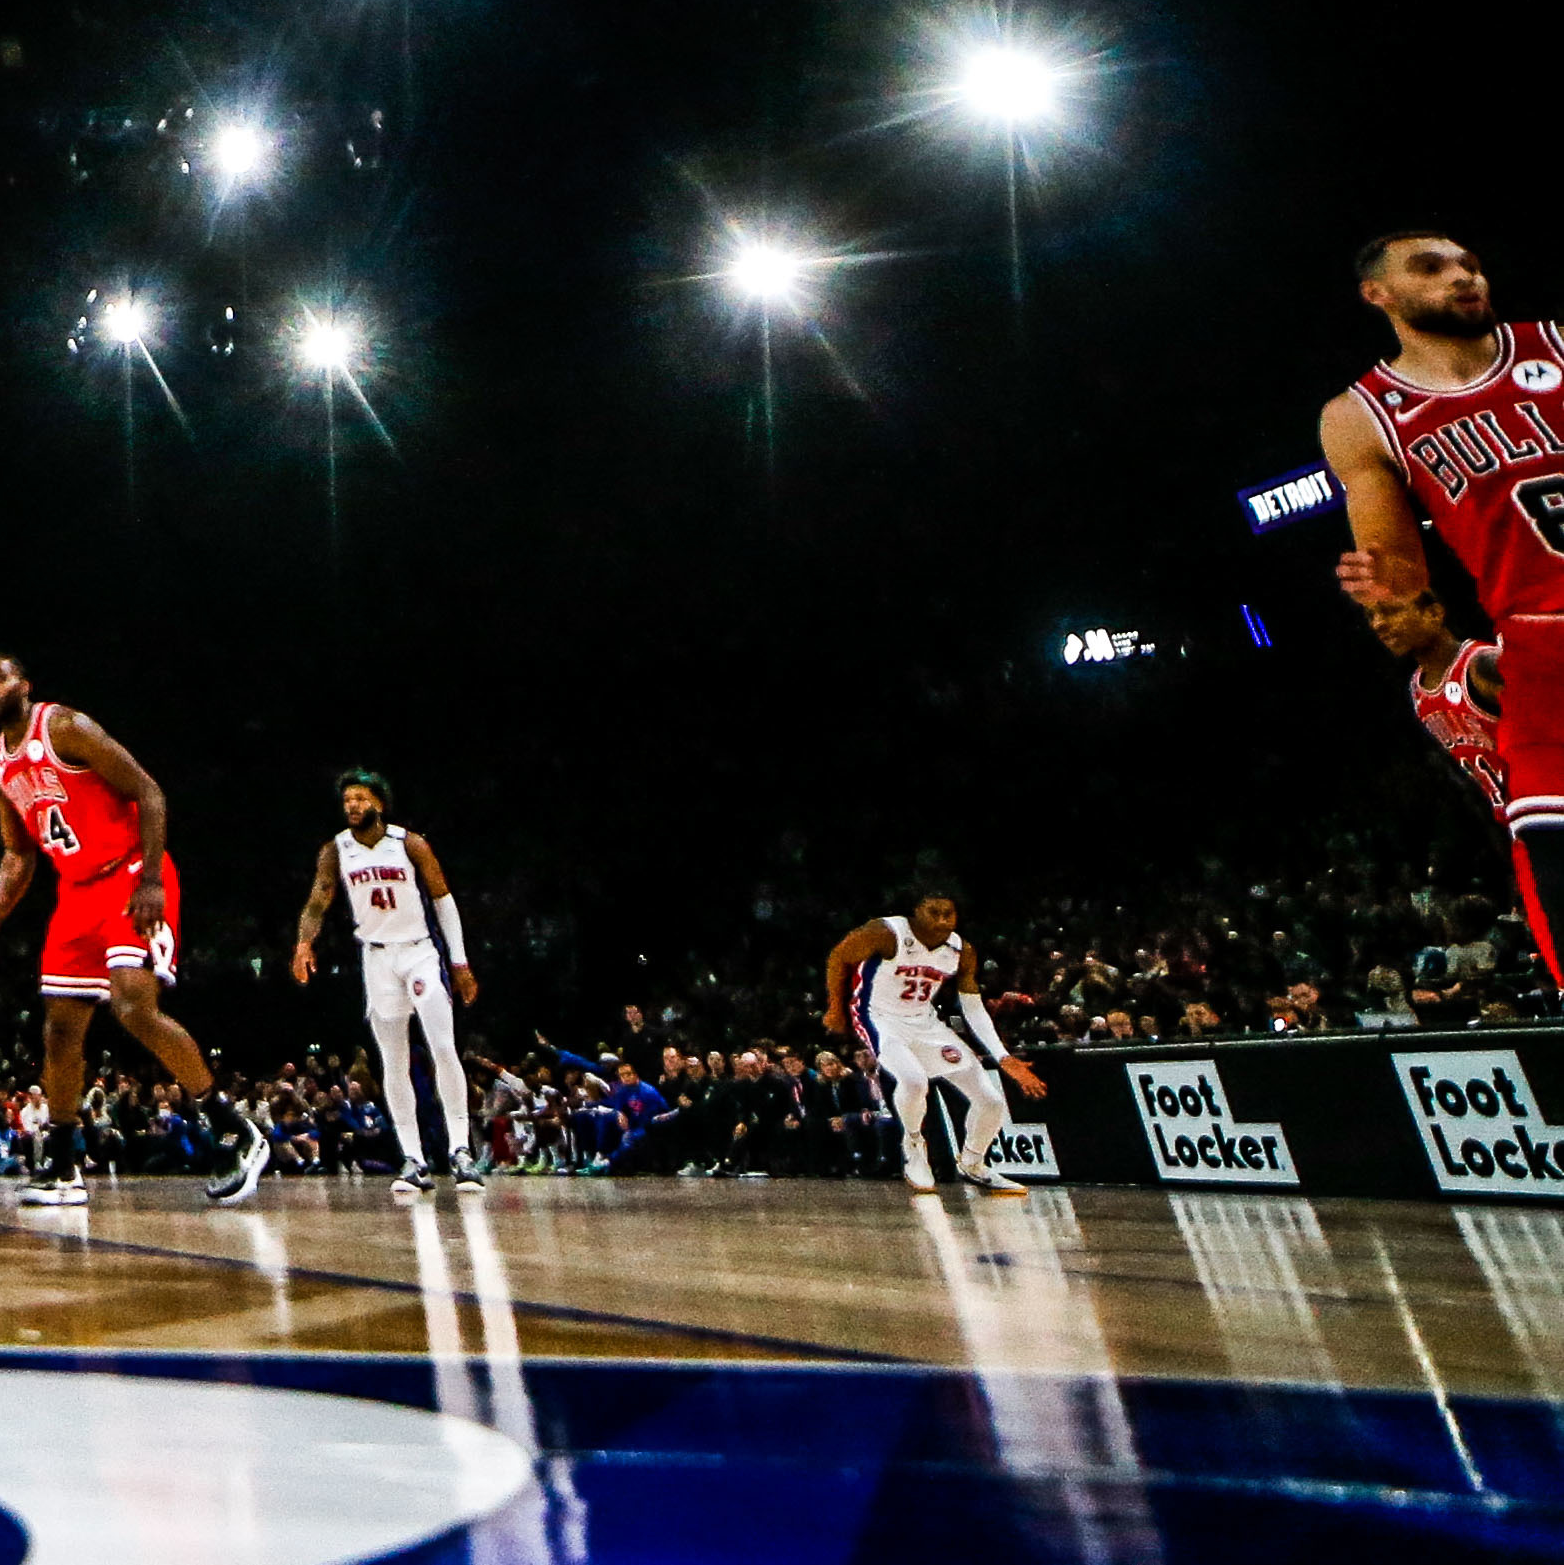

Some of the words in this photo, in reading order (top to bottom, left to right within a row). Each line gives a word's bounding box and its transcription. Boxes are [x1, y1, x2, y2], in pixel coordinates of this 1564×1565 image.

[1407, 400, 1564, 506] BULL
[1248, 470, 1333, 525] DETROIT
[37, 804, 81, 856] 4
[371, 886, 397, 910] 41
[900, 979, 933, 1002] 23
[1138, 1073, 1221, 1118] Foot
[1409, 1065, 1527, 1118] Foot
[984, 1127, 1045, 1167] cker
[1153, 1122, 1281, 1170] Locker
